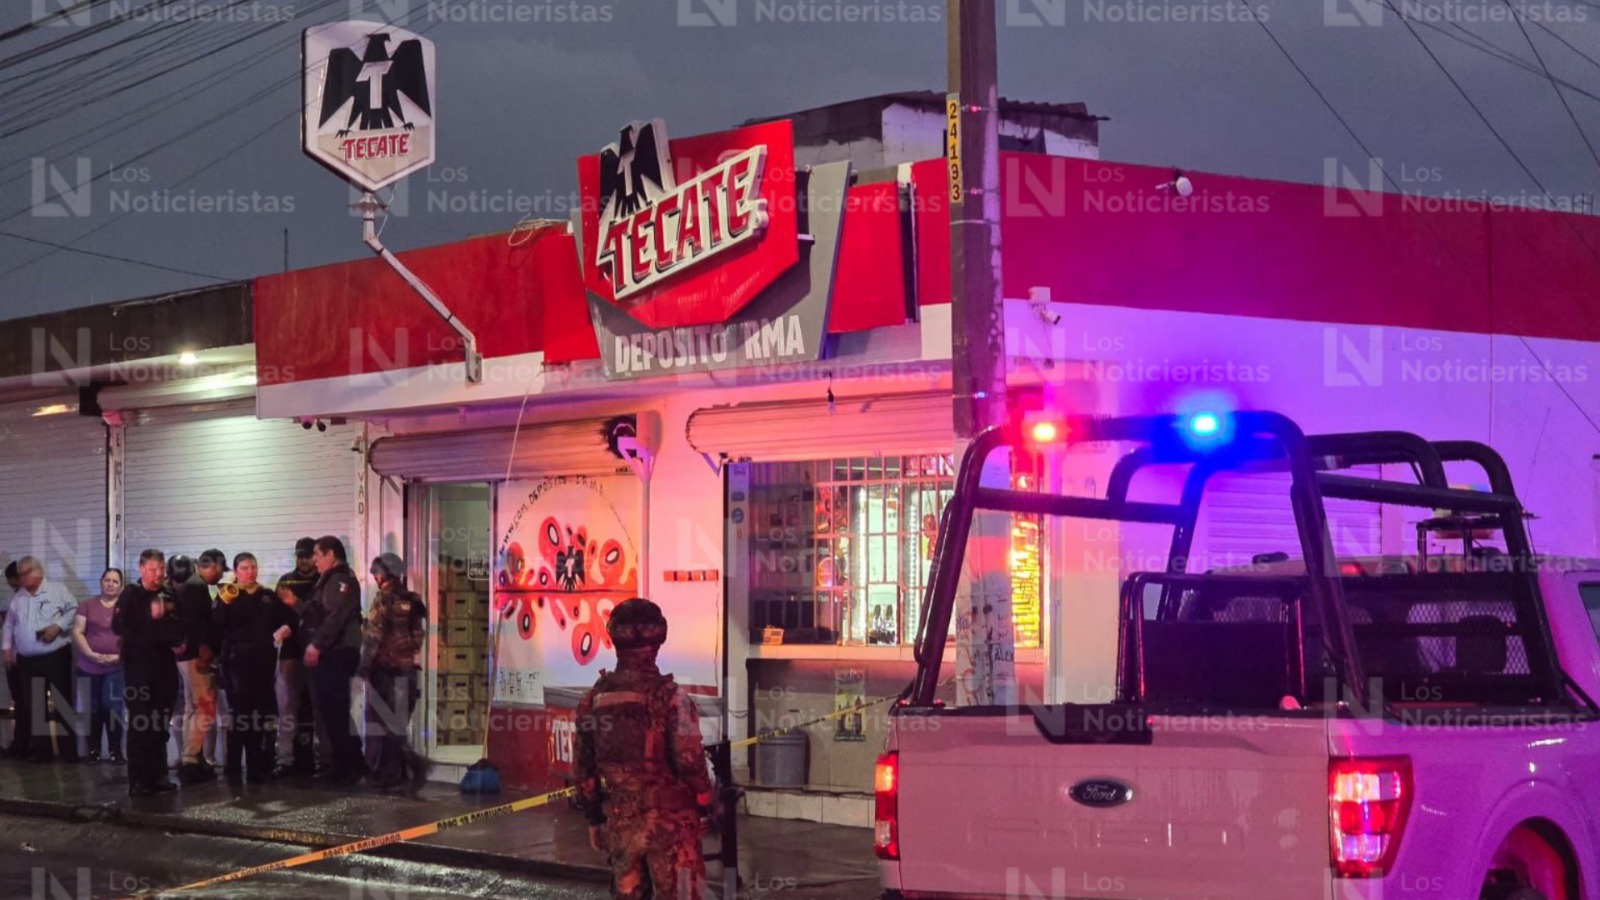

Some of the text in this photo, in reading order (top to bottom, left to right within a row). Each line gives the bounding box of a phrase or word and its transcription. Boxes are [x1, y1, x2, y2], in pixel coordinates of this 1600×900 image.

[342, 133, 410, 161] TECATE
[600, 154, 752, 294] TECATE
[614, 325, 727, 374] DEPOSITO
[1083, 784, 1117, 801] Ford
